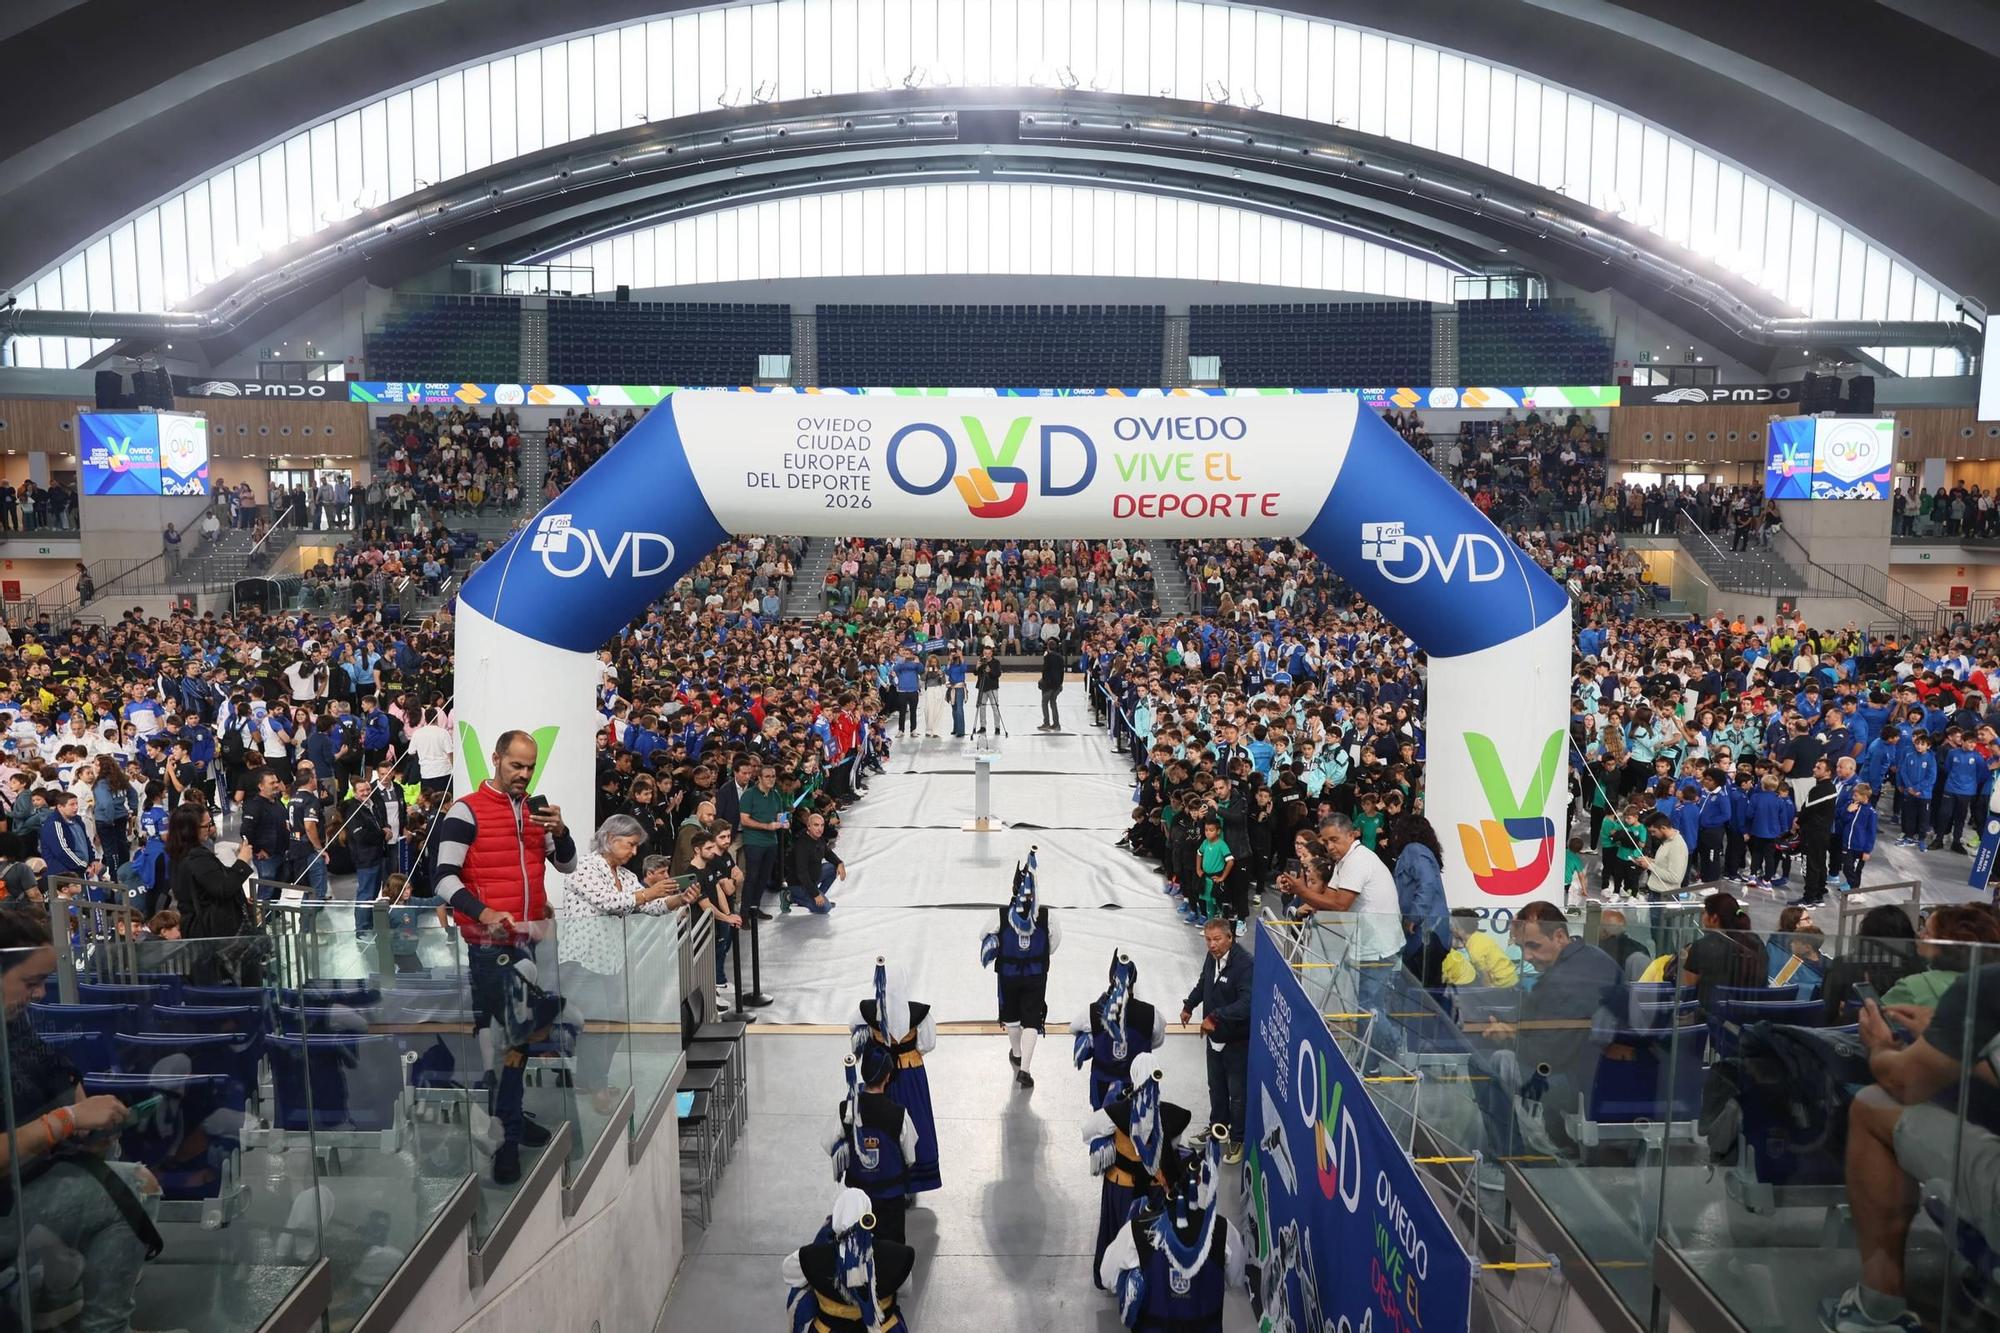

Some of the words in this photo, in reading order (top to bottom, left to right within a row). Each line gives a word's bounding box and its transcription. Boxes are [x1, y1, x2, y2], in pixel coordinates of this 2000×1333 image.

[797, 417, 872, 433] OVIEDO
[1113, 416, 1247, 441] OVIEDO
[796, 434, 872, 451] CIUDAD
[783, 453, 871, 472] EUROPEA
[1113, 452, 1195, 482] VIVE
[1204, 453, 1242, 482] EL
[747, 472, 780, 488] DEL
[787, 473, 871, 491] DEPORTE
[825, 493, 872, 509] 2026
[1113, 492, 1281, 519] DEPORTE
[541, 527, 675, 579] OVD
[1376, 533, 1505, 584] OVD
[1298, 1039, 1361, 1214] OVD
[1376, 1170, 1428, 1281] OVIEDO
[1373, 1210, 1405, 1293] VIVE
[1406, 1273, 1423, 1329] EL
